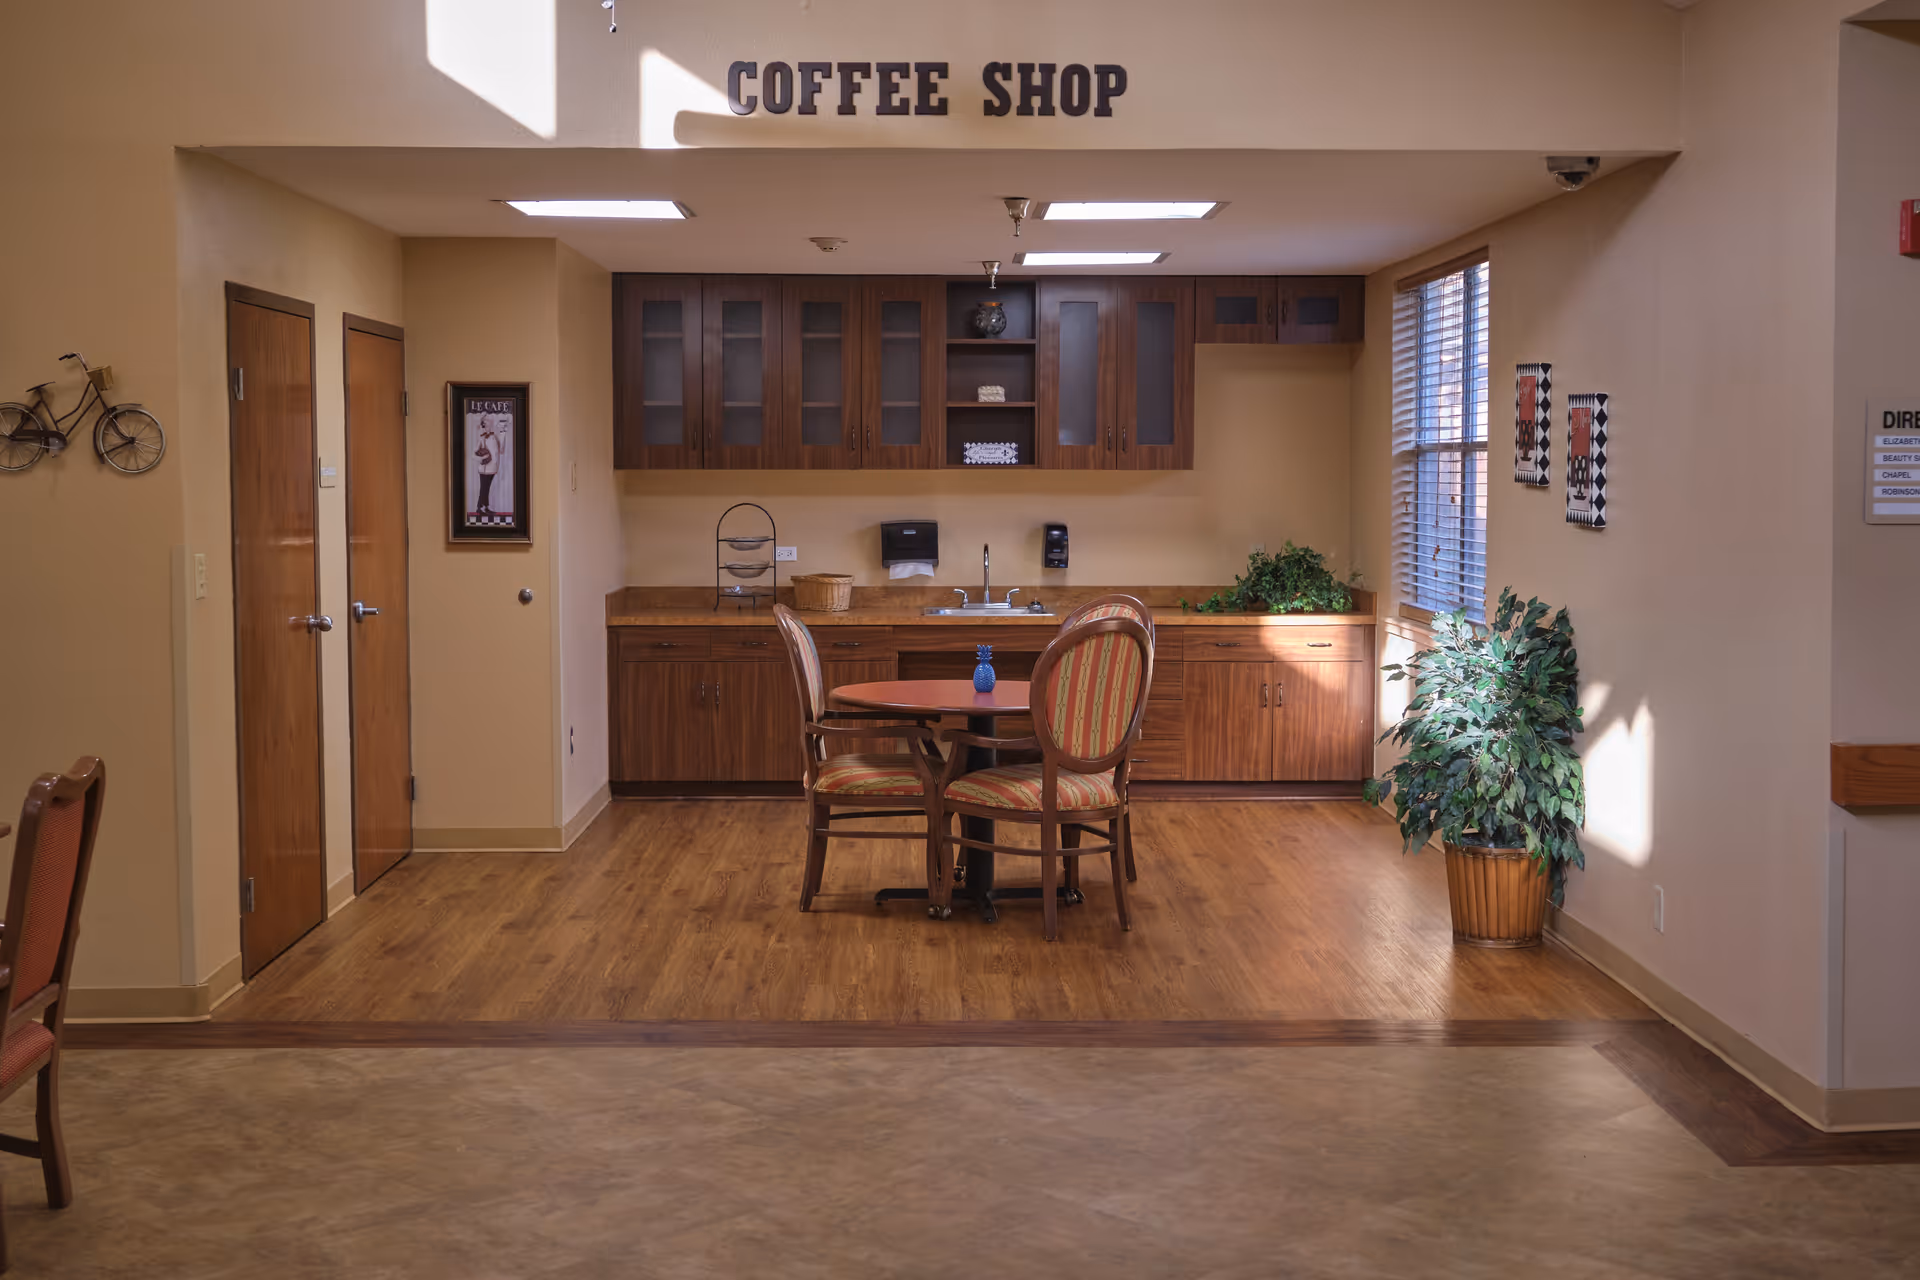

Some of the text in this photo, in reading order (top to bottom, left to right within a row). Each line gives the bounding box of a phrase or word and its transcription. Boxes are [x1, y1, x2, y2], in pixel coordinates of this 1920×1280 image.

[727, 61, 1128, 117] COFFEE SHOP
[471, 400, 483, 411] LE
[1883, 410, 1920, 429] DIRE
[1882, 454, 1912, 462] BEAUTY
[1881, 471, 1911, 479] CHAPEL
